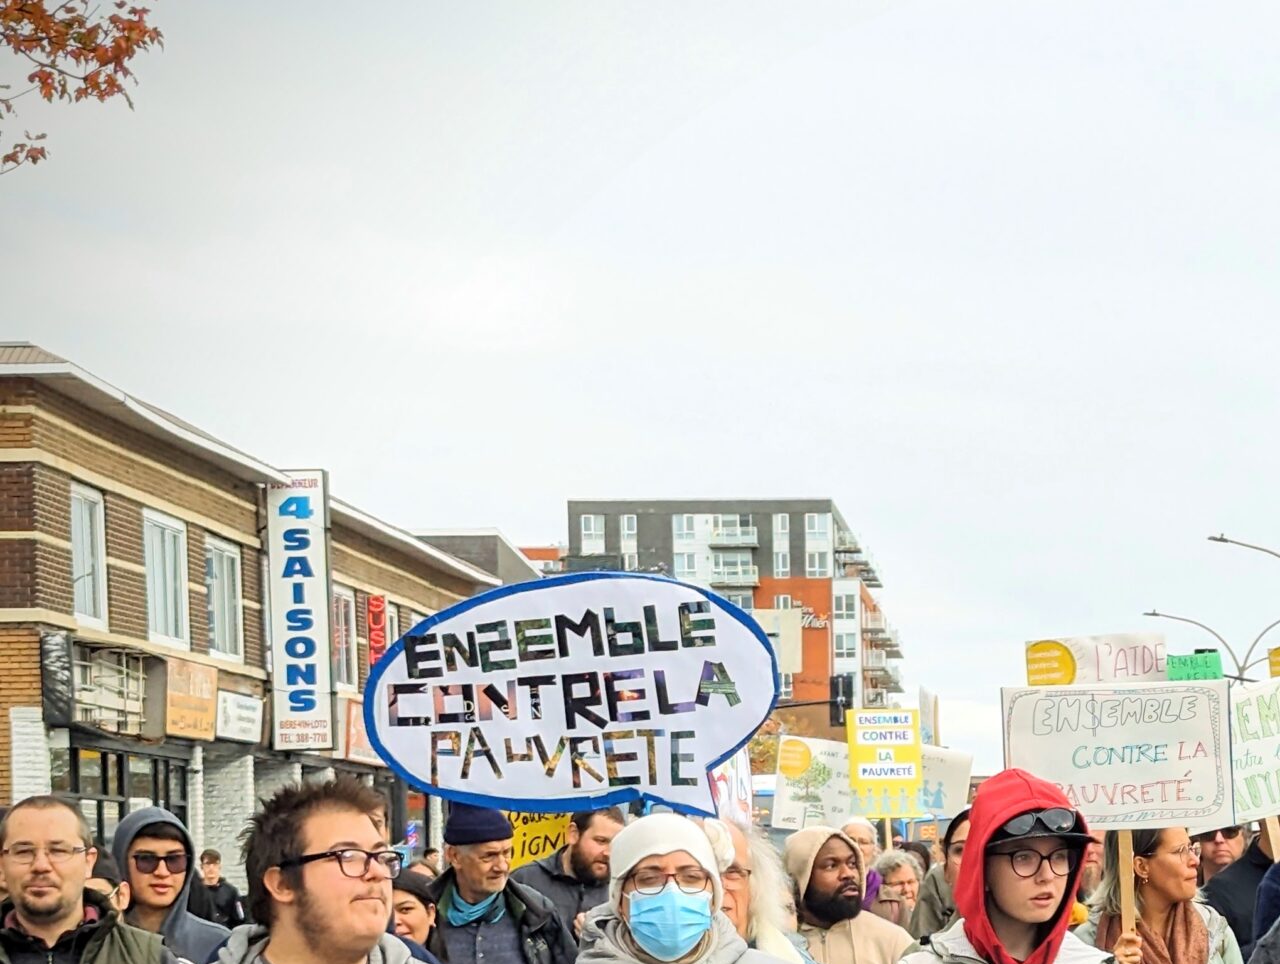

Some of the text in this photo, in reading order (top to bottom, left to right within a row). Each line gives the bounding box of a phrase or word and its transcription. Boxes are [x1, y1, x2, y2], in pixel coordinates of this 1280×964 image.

[279, 495, 314, 520] 4
[281, 527, 318, 713] SAISONS
[368, 594, 386, 665] SUSH
[858, 714, 909, 725] ENSEMBLE
[862, 730, 909, 742] CONTRE
[878, 751, 893, 762] LA
[1072, 740, 1208, 769] CONTRE LA
[1231, 748, 1263, 770] ntre
[861, 765, 913, 777] PAUVRETÉ
